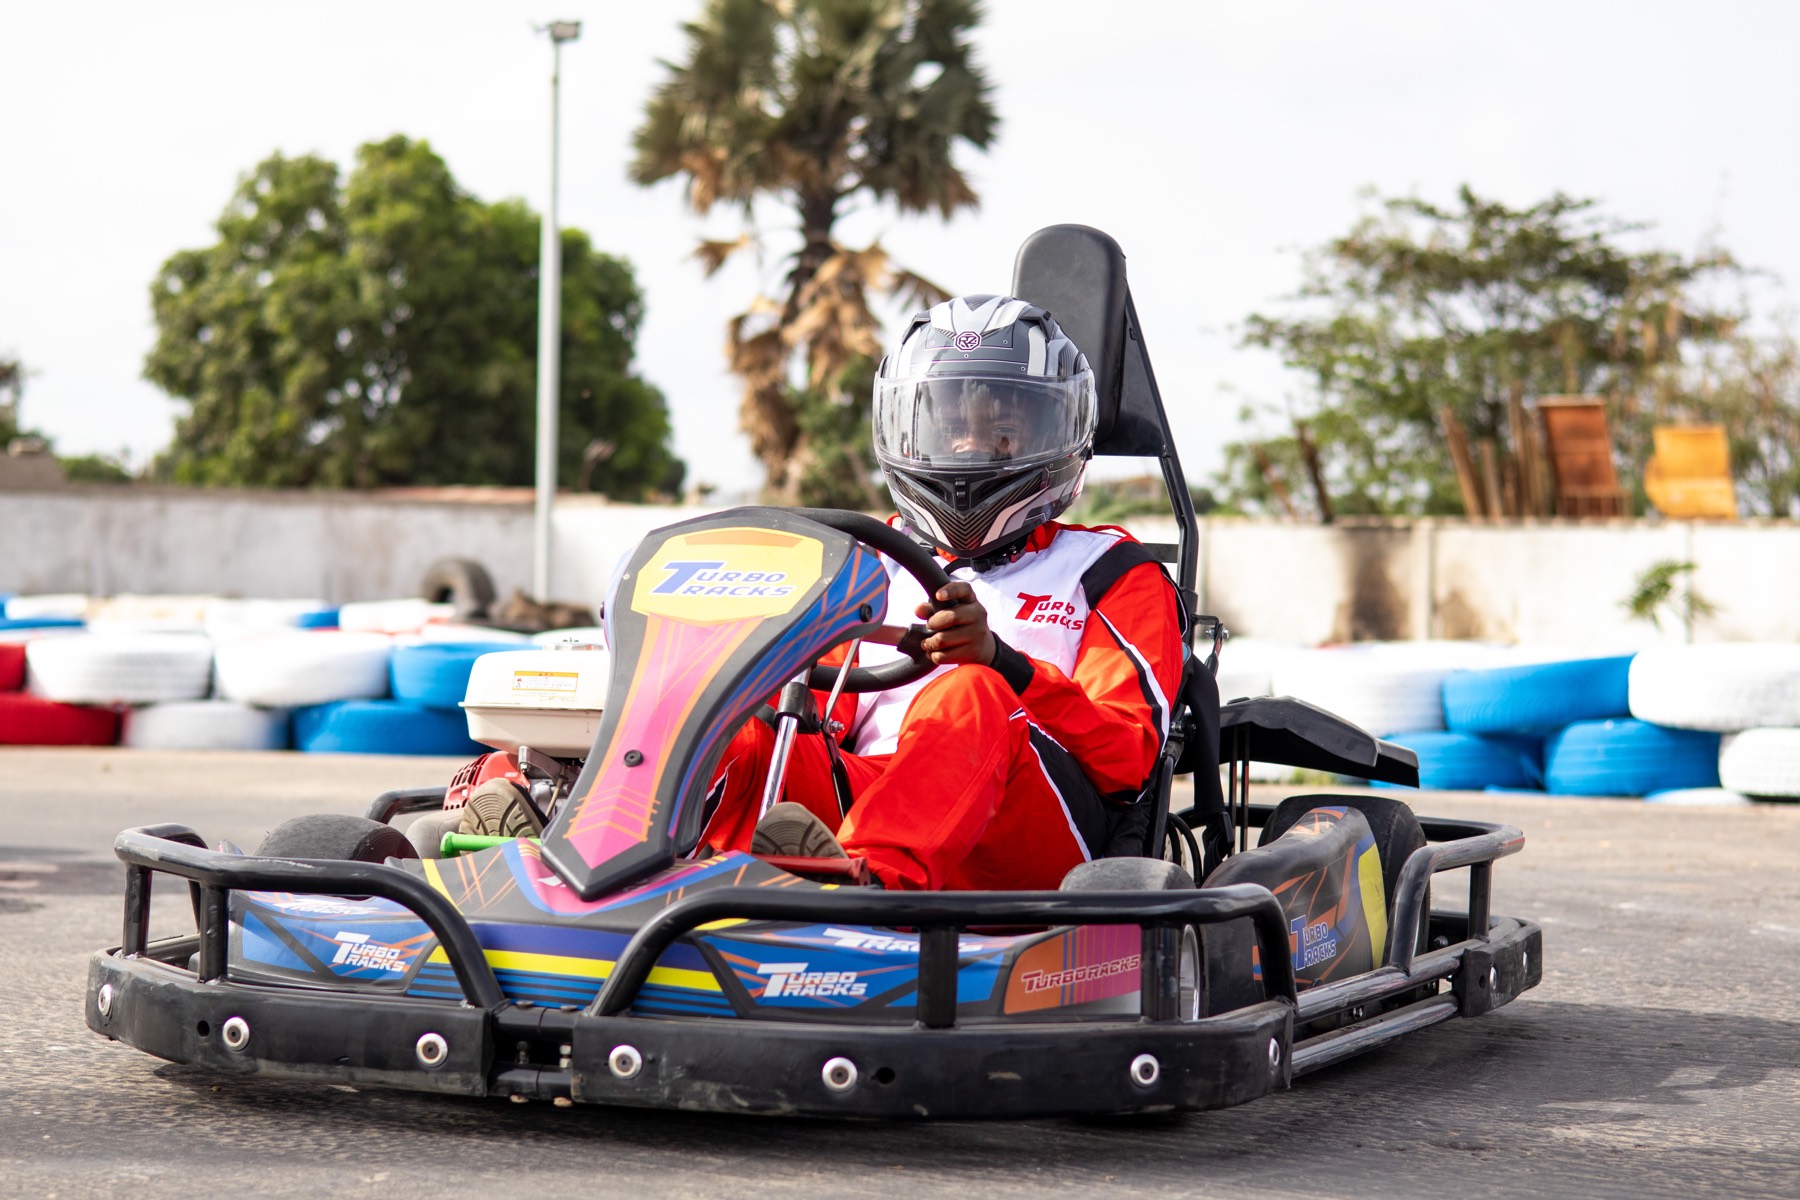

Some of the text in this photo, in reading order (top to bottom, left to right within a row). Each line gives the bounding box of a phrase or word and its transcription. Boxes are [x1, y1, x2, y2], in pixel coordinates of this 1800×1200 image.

[652, 562, 785, 594] TURBO
[332, 931, 401, 964] TURBO
[1291, 914, 1328, 971] TURBO
[757, 963, 857, 997] TURBO
